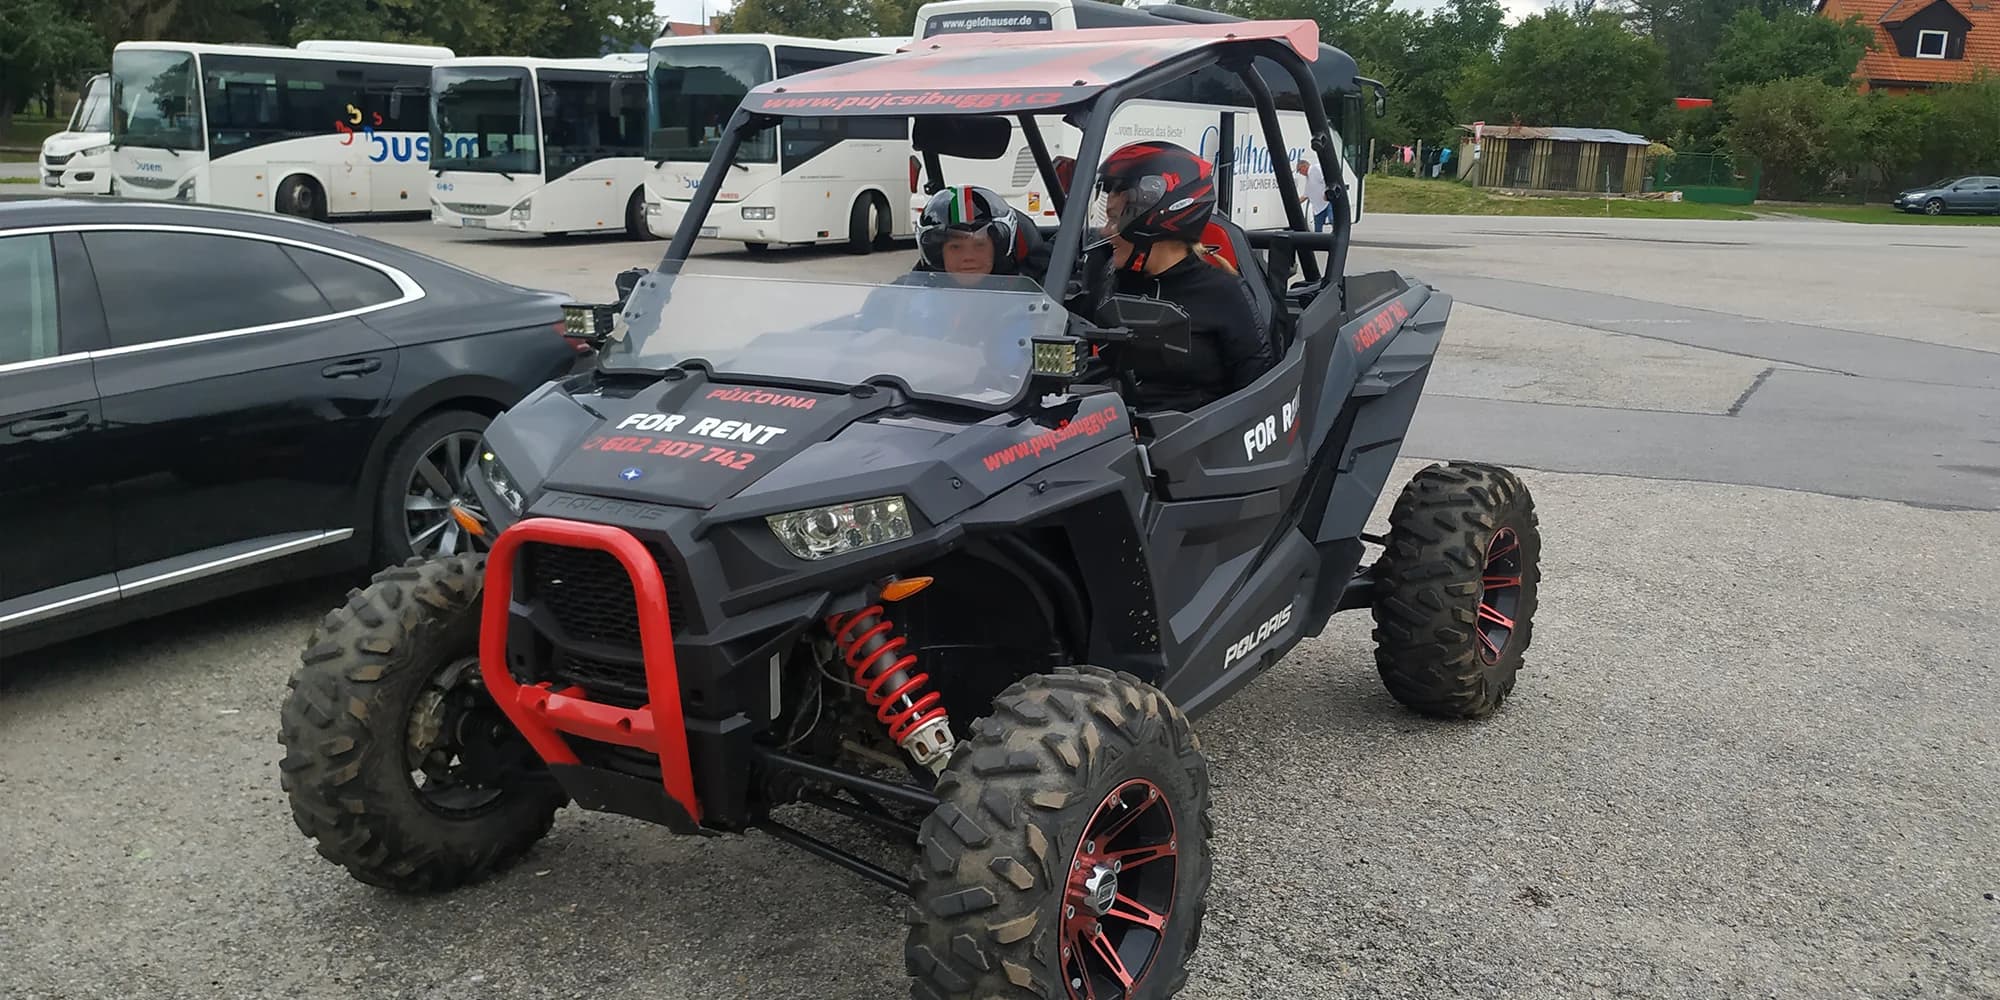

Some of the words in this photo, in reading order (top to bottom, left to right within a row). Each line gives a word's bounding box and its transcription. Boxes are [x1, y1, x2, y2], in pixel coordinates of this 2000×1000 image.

[942, 15, 1032, 30] www.geldhauser.de
[762, 92, 1063, 110] www.pujcsibuggy.cz
[616, 413, 687, 433] FOR
[688, 416, 788, 446] RENT
[1243, 414, 1277, 461] FOR
[600, 436, 646, 453] 602
[647, 438, 705, 459] 307
[700, 446, 756, 471] 742
[547, 495, 668, 521] POLARIS
[1223, 602, 1294, 670] POLARIS
